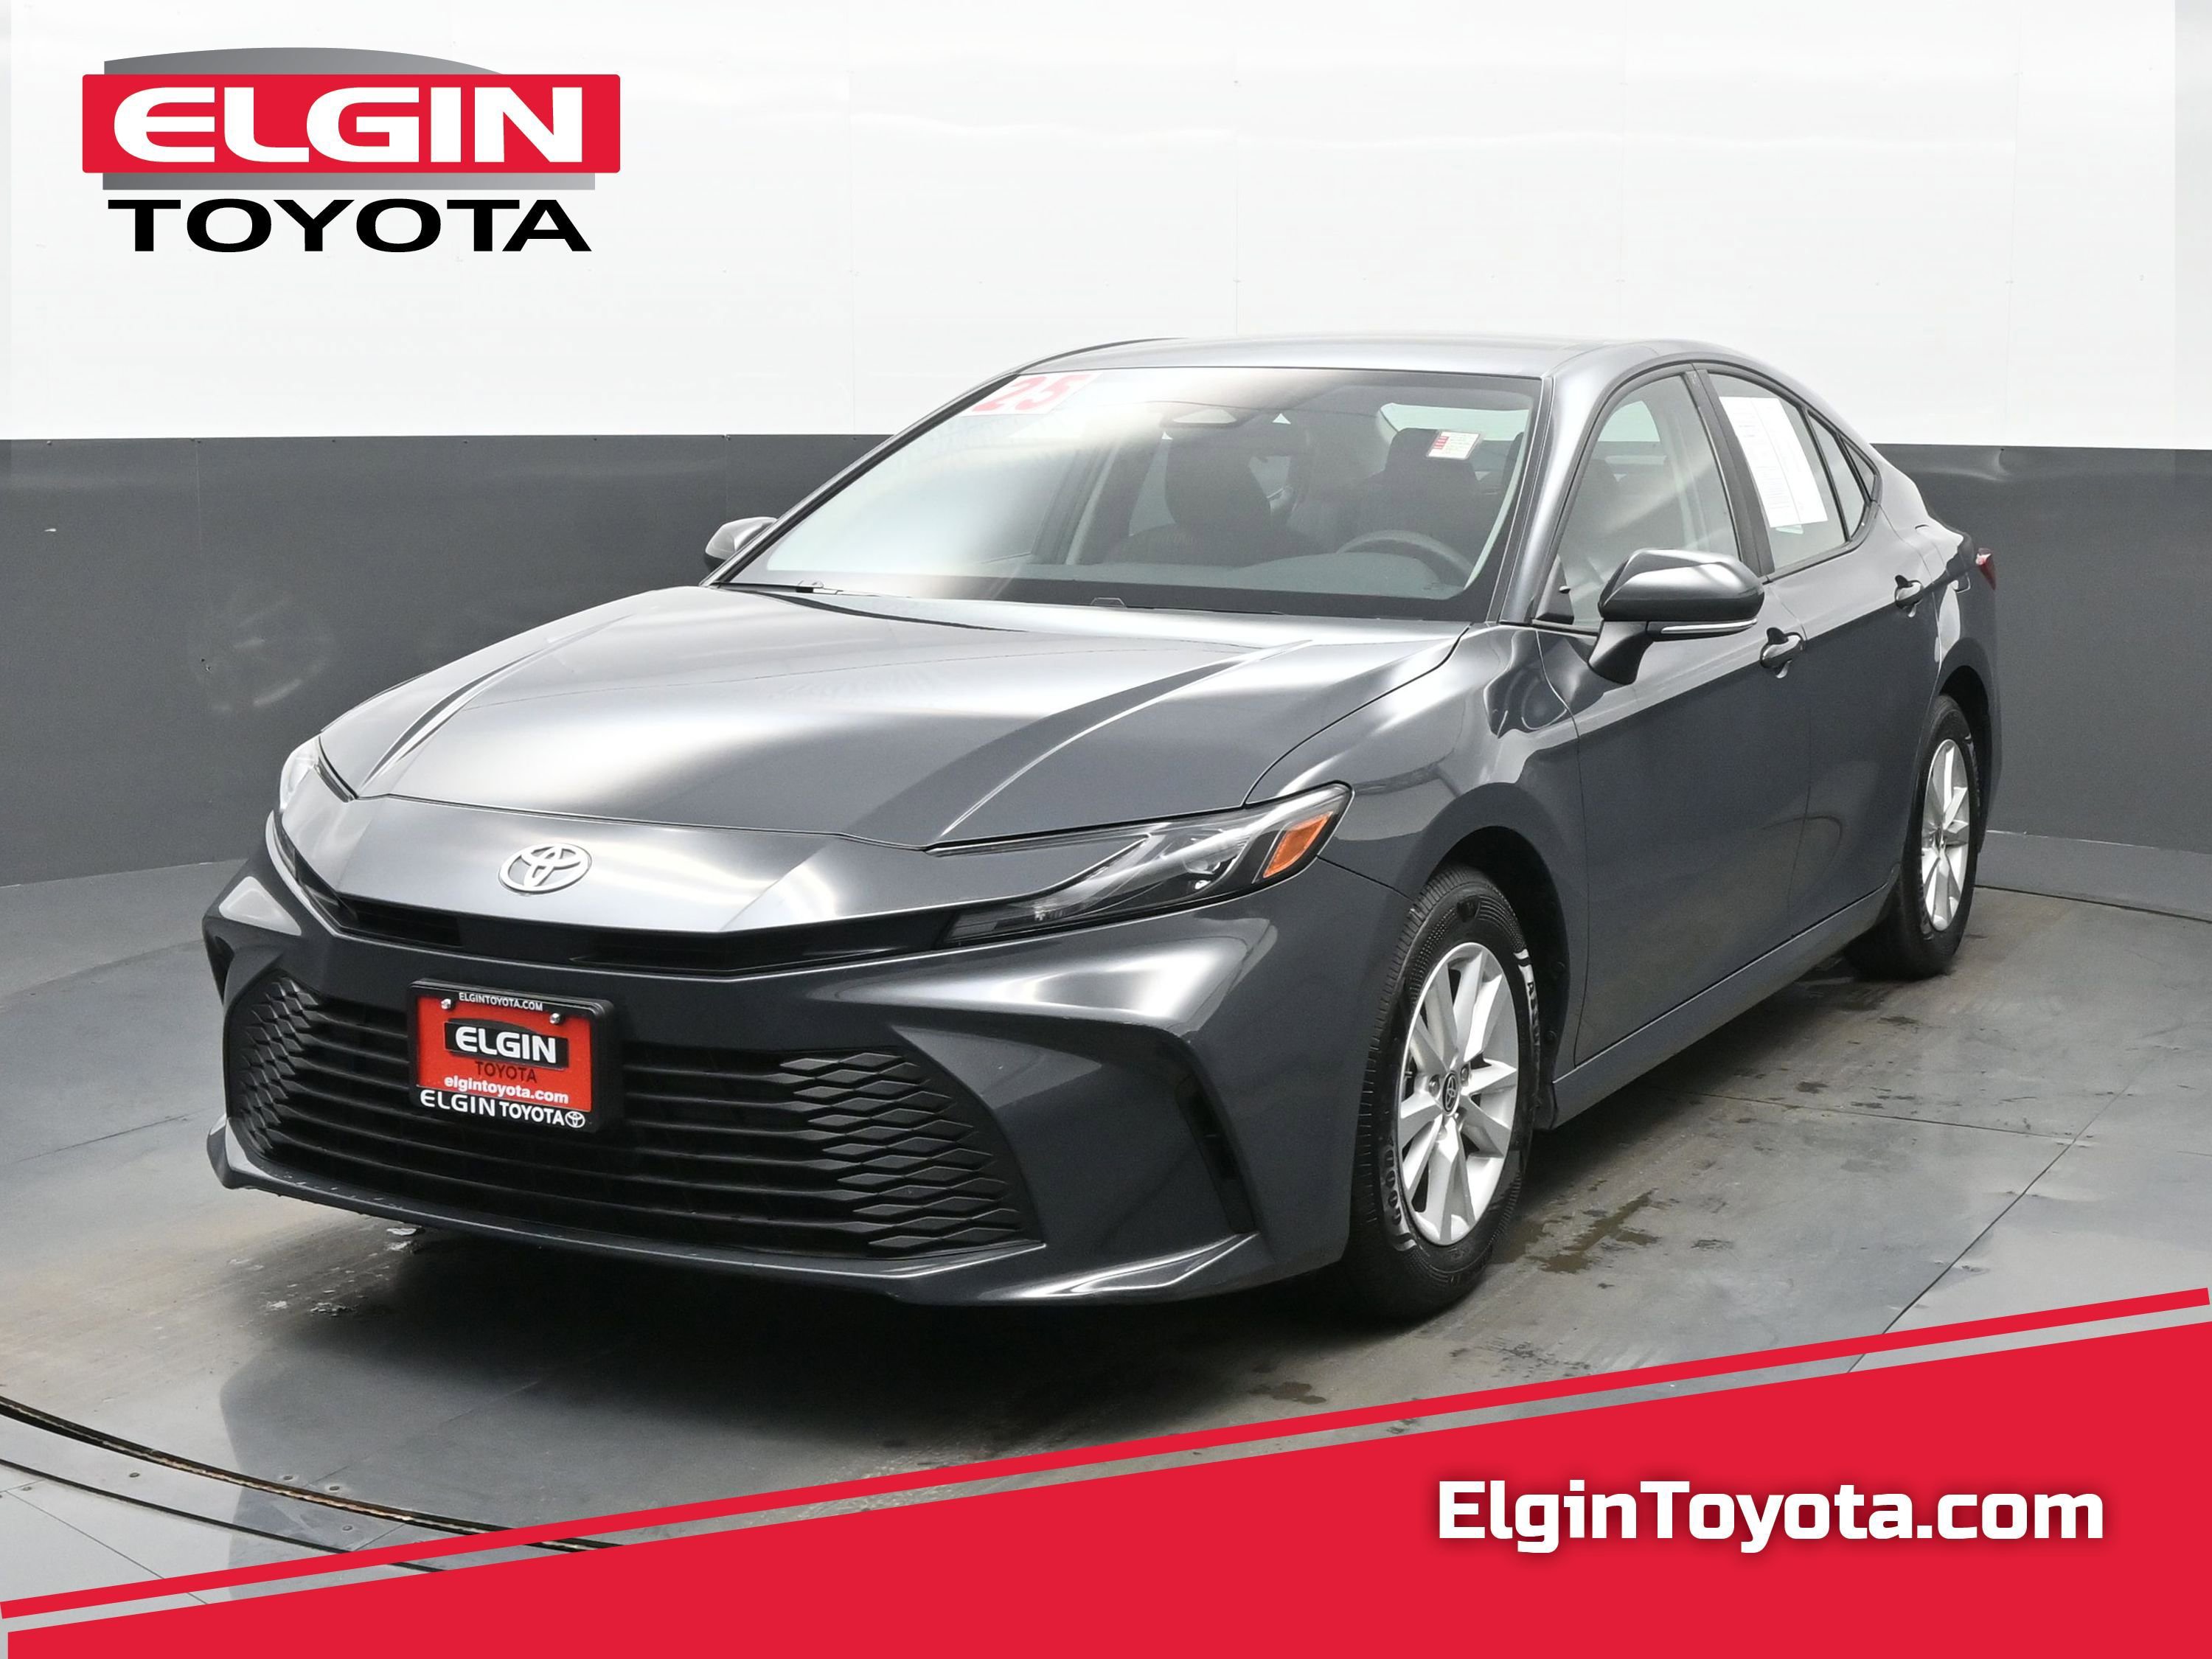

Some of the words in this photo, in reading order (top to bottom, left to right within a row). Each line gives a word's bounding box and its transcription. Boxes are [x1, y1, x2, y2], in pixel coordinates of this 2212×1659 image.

[972, 374, 1093, 412] 25
[459, 992, 543, 1011] ELGINTOYOTA.COM
[456, 1026, 557, 1063] ELGIN
[475, 1061, 537, 1083] TOYOTA
[444, 1076, 568, 1104] elgintoyota.com
[420, 1089, 495, 1116] ELGIN
[499, 1102, 565, 1125] TOYOTA
